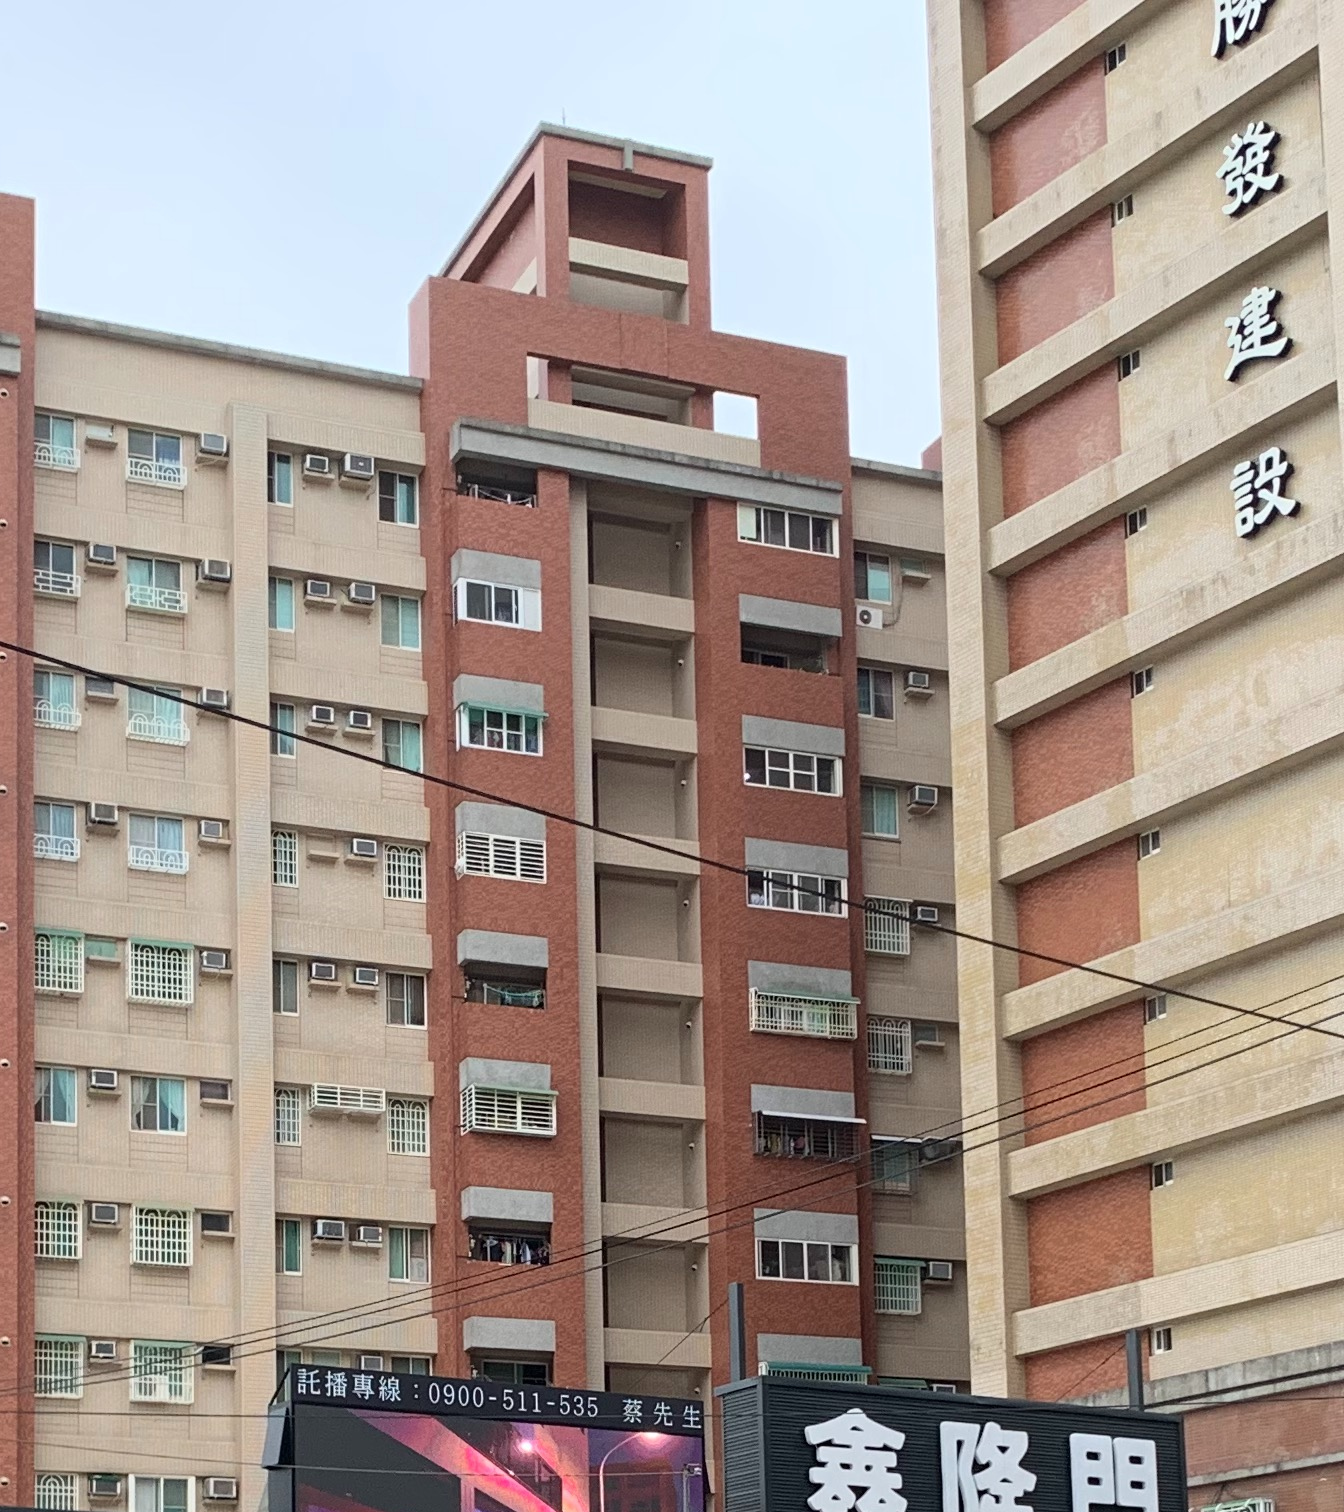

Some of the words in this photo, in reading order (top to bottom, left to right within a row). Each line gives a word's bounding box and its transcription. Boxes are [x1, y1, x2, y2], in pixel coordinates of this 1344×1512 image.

[428, 1382, 599, 1419] 0900-511-535
[622, 1398, 703, 1430] 蔡先生
